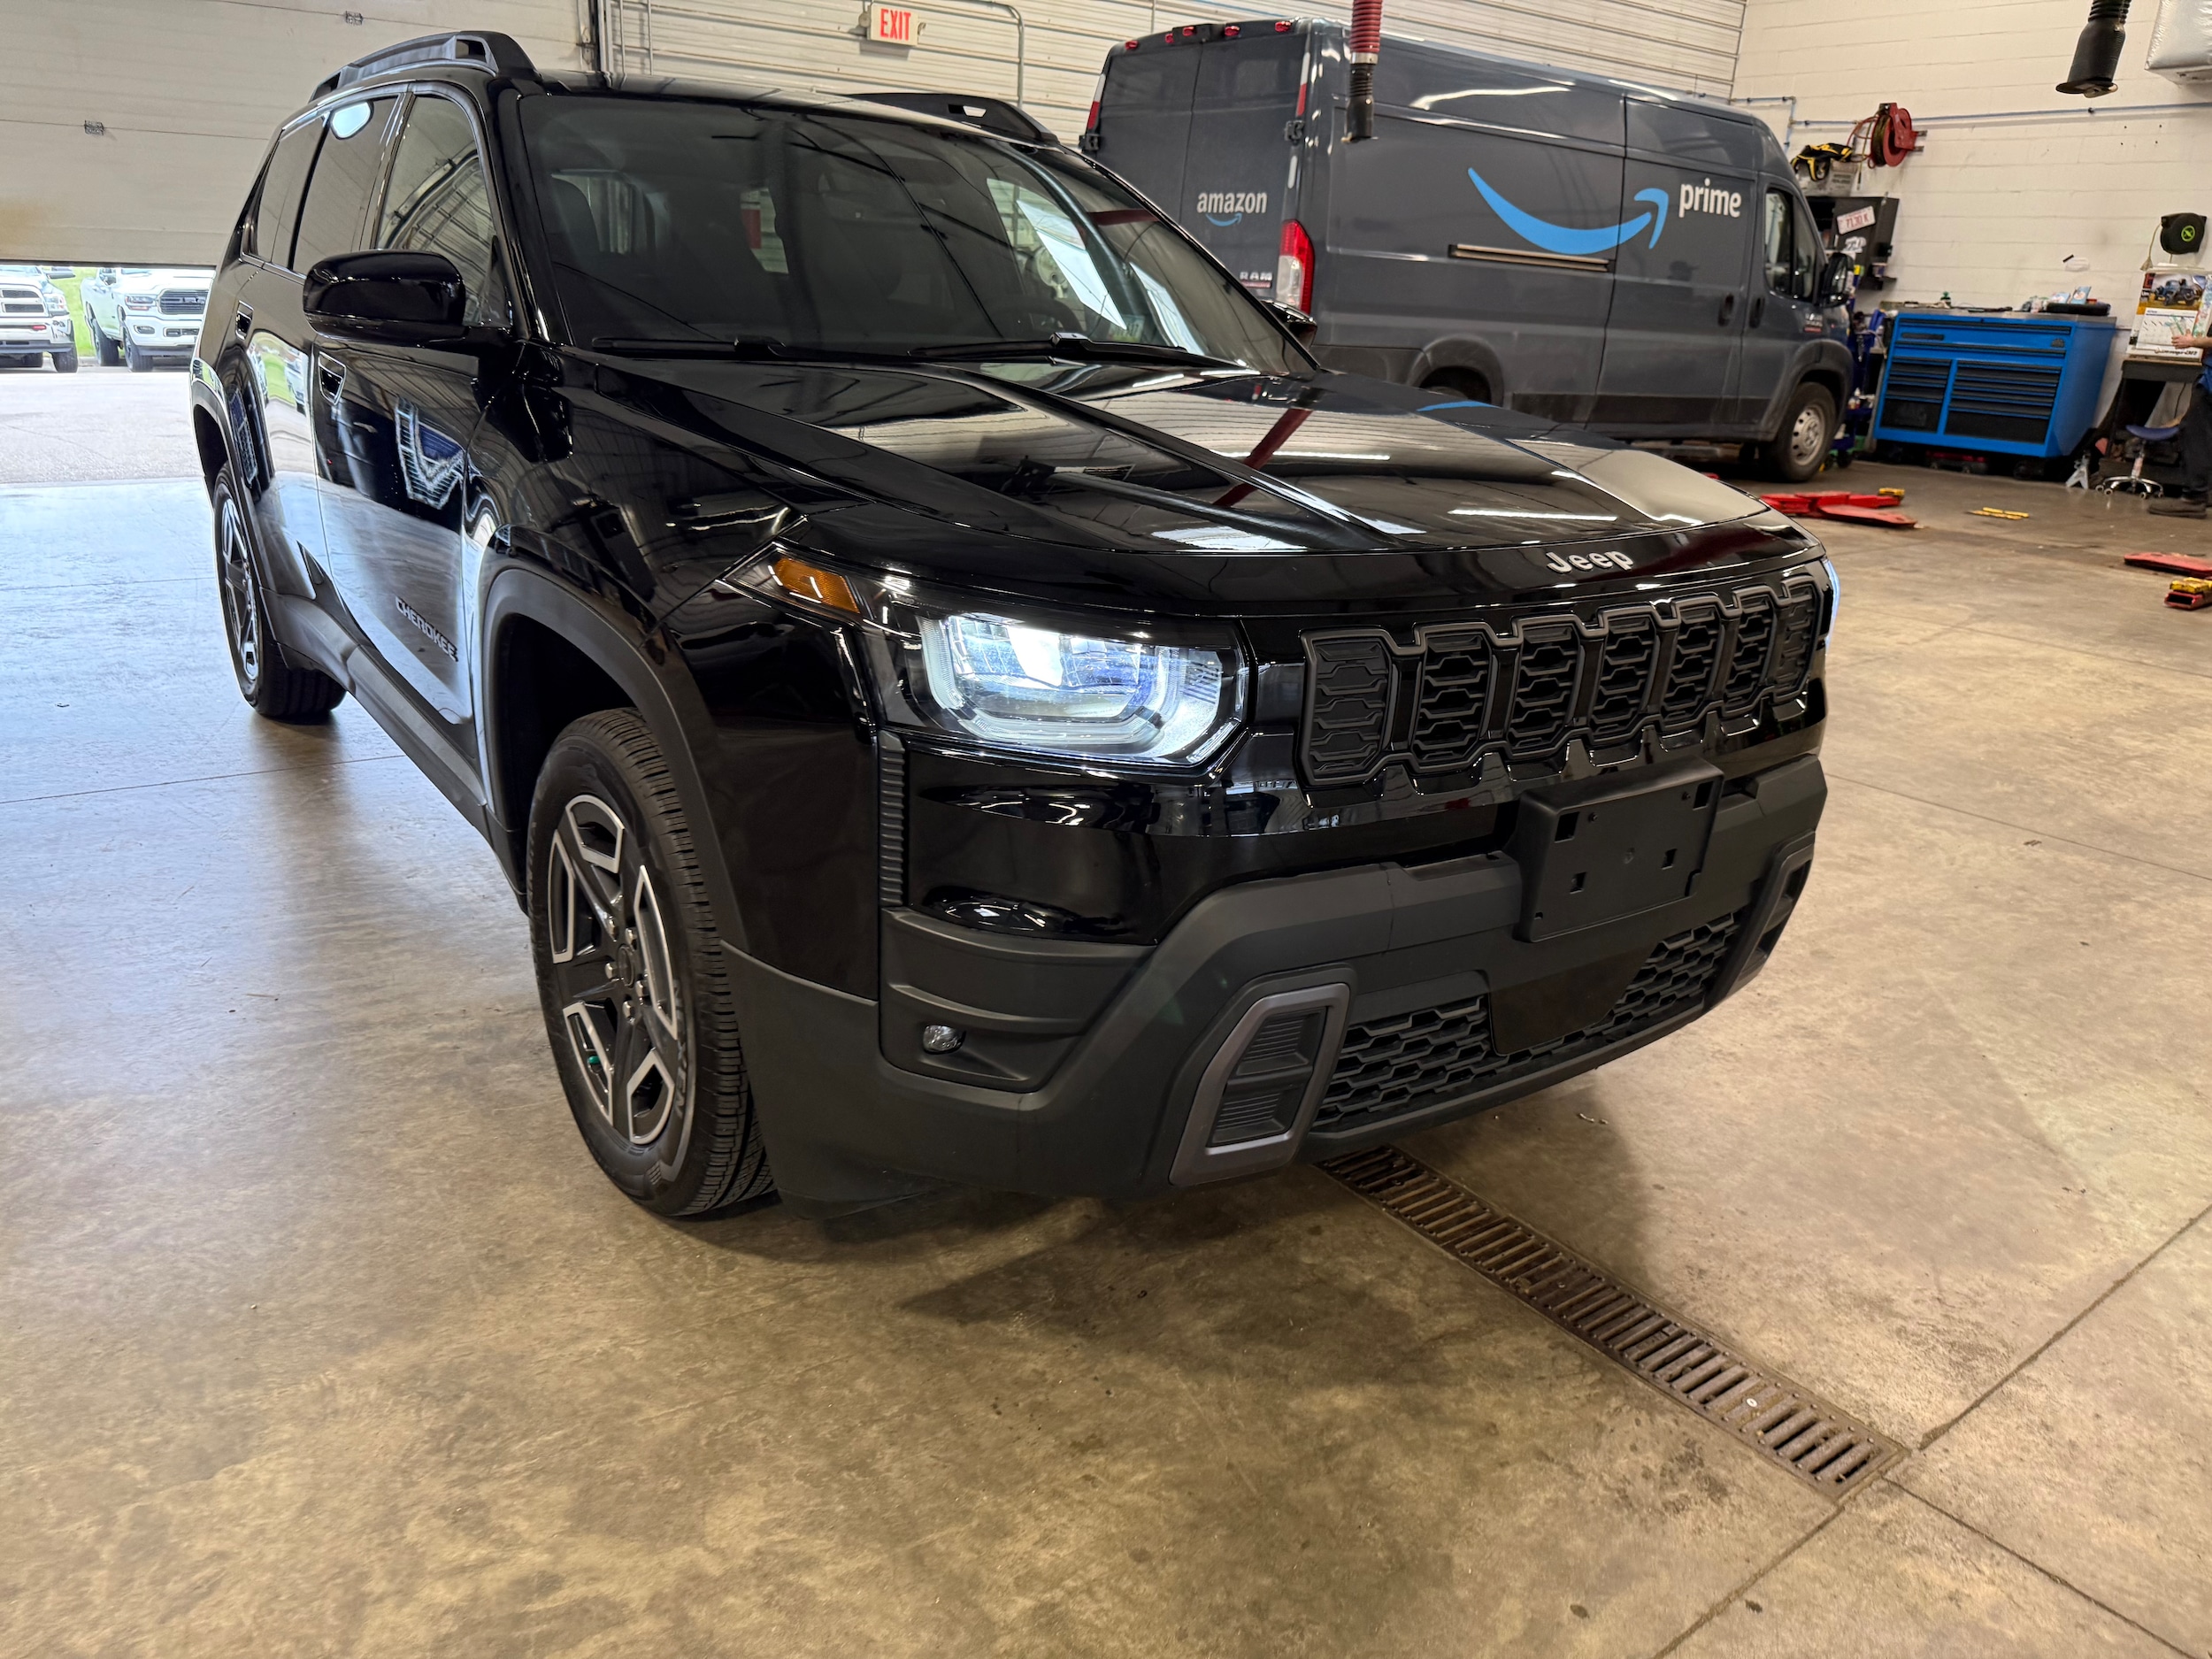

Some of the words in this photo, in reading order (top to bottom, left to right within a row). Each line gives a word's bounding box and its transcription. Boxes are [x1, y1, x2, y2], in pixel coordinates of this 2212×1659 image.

[880, 8, 911, 41] EXIT
[1196, 192, 1267, 213] amazon
[1678, 178, 1741, 218] prime
[1240, 272, 1272, 280] RAM
[1545, 550, 1633, 573] Jeep
[395, 595, 458, 662] CHEROKEE
